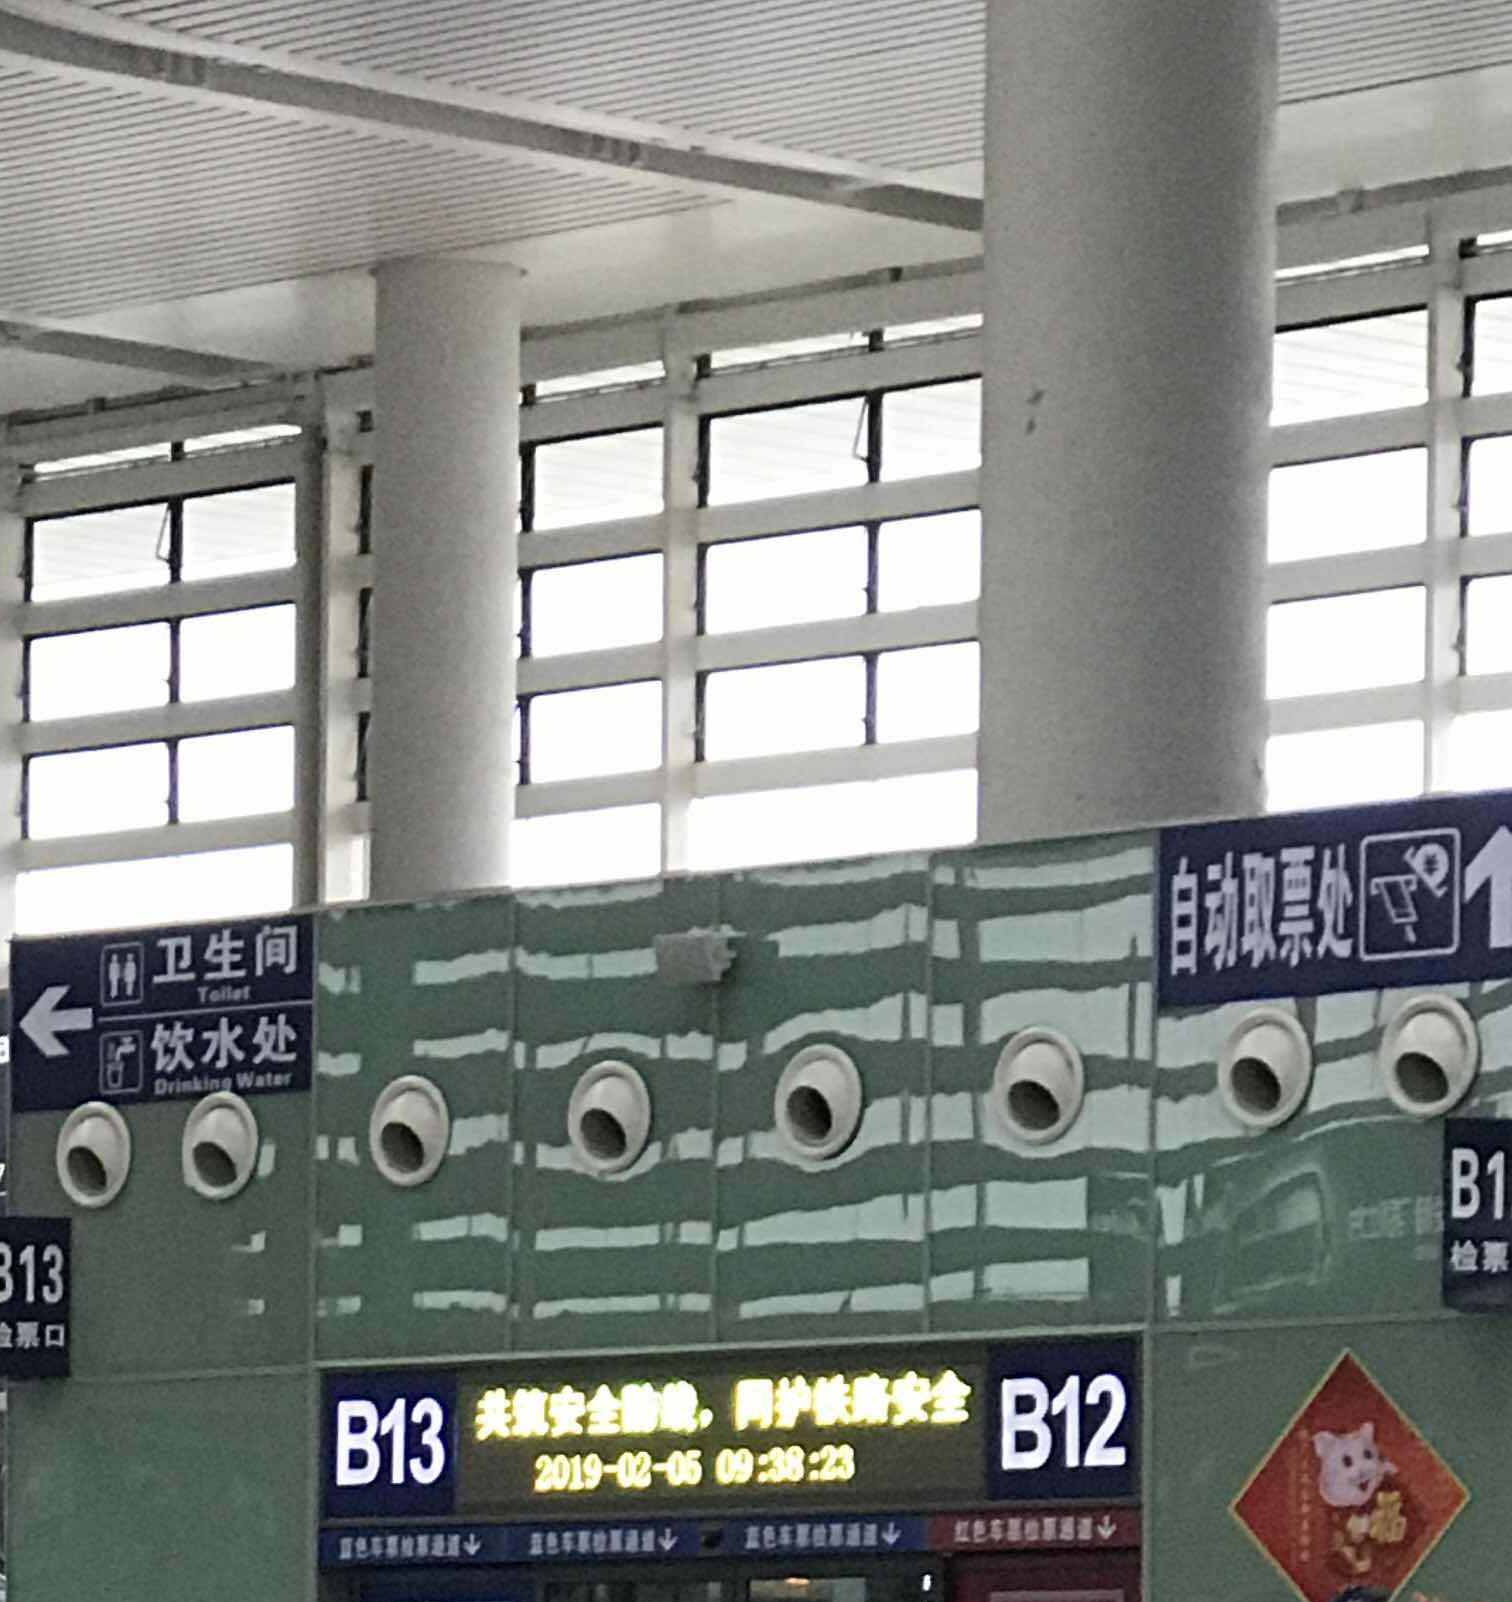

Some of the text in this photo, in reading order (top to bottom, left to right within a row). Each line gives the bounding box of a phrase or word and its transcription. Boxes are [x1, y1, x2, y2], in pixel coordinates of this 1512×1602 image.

[1171, 844, 1354, 977] 自动取票处
[152, 925, 298, 985] 卫生间
[197, 985, 251, 1003] Toilet
[151, 1014, 298, 1073] 饮水处
[154, 1072, 293, 1096] Drinking Water
[1450, 1240, 1509, 1273] 检票
[335, 1396, 446, 1487] B13
[1000, 1373, 1128, 1472] B12
[715, 1444, 855, 1485] 09:38:23
